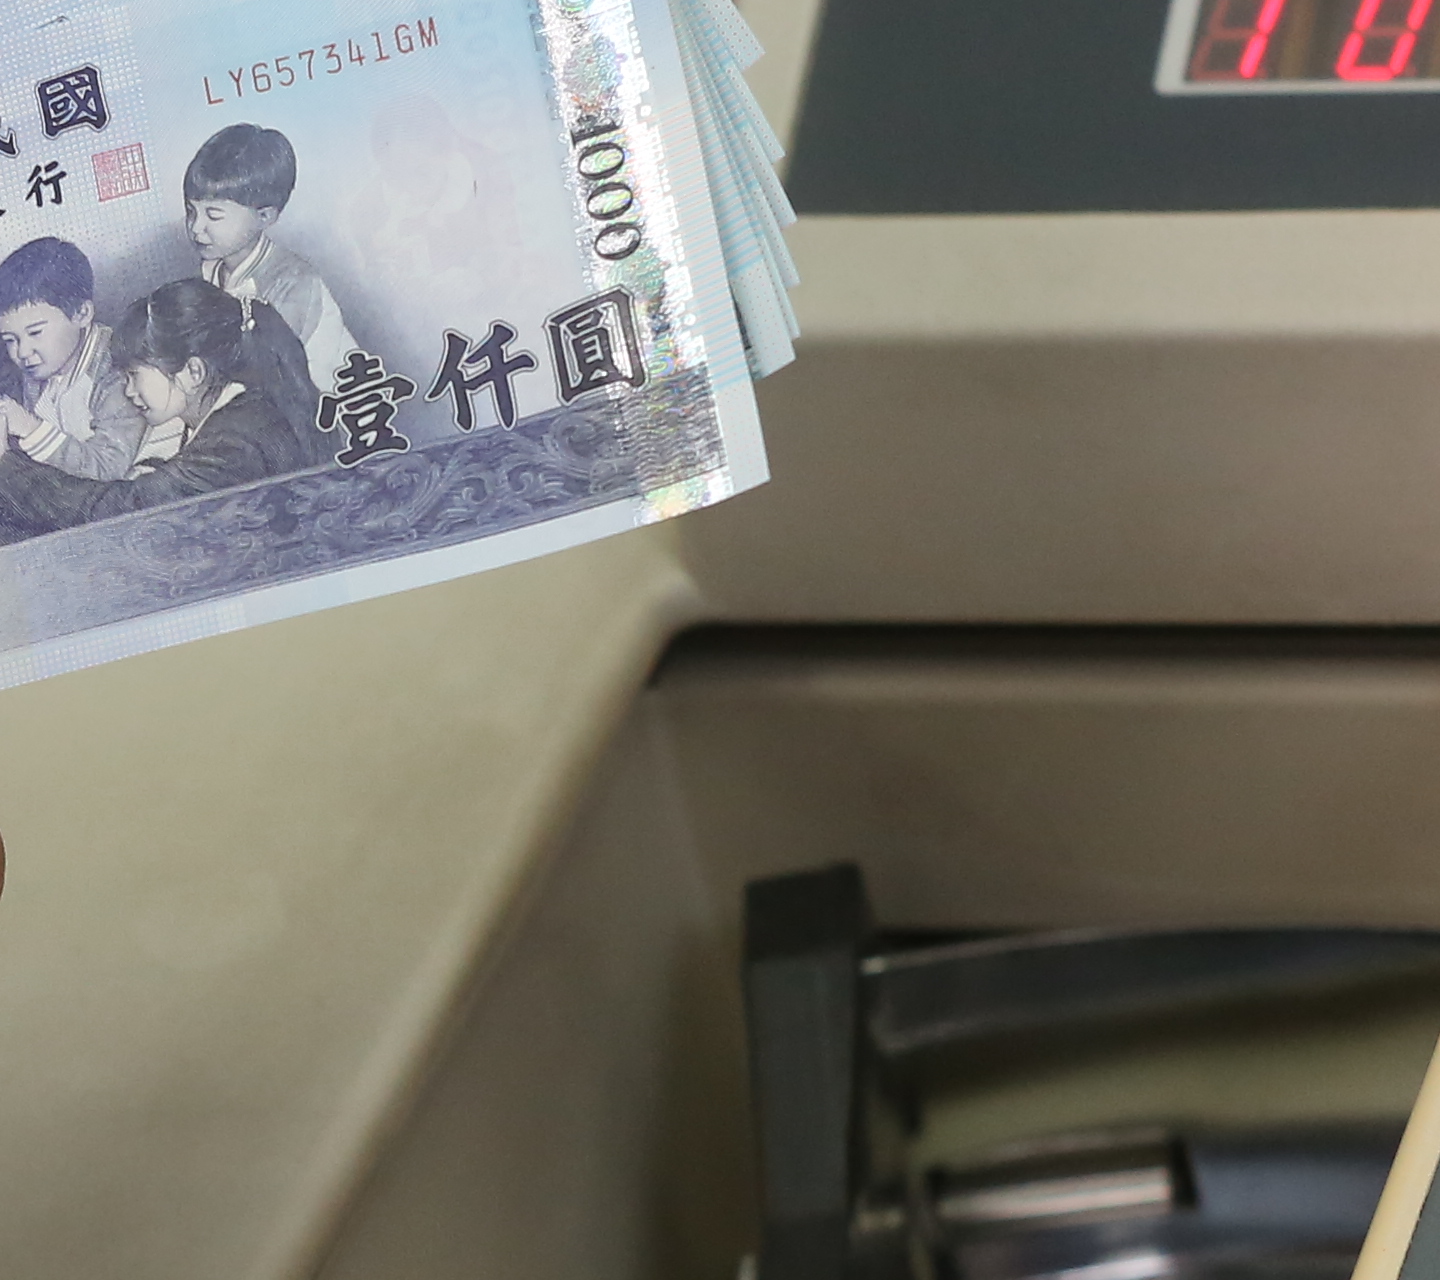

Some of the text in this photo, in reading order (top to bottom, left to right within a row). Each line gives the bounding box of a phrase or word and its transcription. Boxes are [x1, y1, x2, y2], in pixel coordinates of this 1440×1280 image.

[203, 16, 439, 106] LY657341GM
[569, 114, 643, 262] 1000
[316, 284, 649, 469] 壹仟圓
